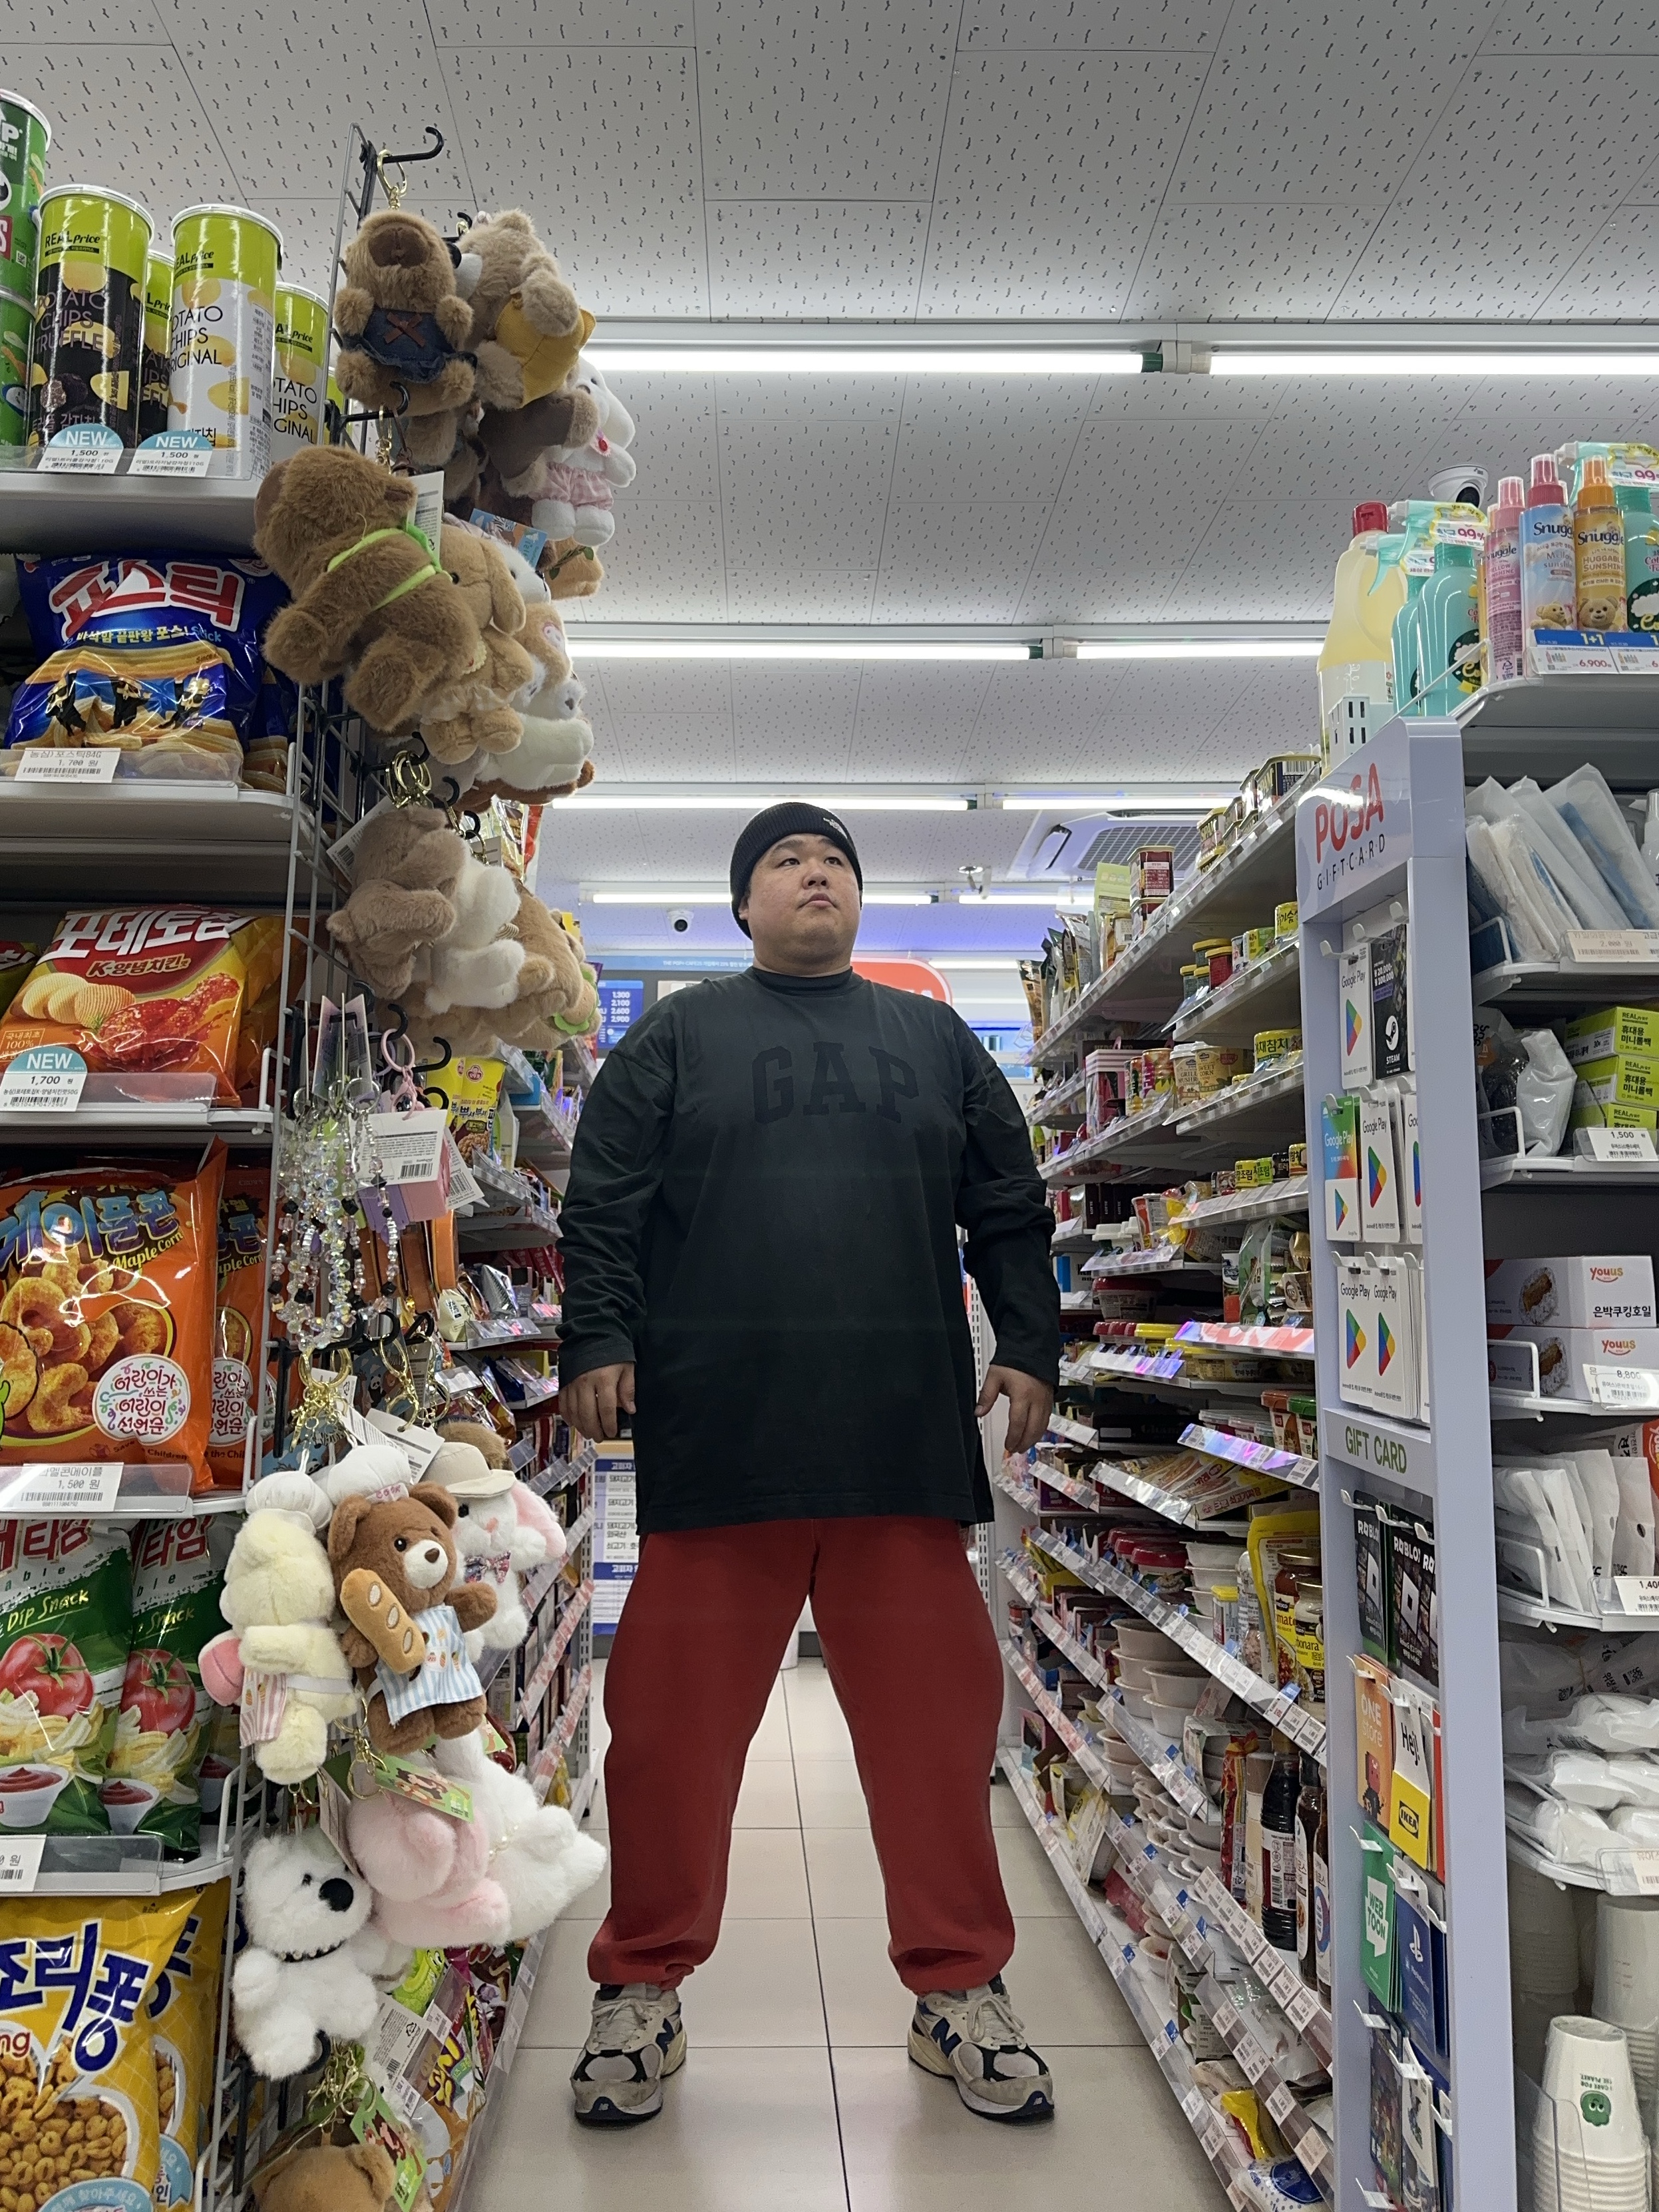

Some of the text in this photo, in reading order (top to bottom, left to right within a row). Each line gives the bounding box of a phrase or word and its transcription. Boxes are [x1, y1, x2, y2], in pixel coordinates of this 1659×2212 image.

[65, 431, 108, 447] NEW
[155, 436, 199, 449] NEW
[51, 559, 242, 639] 포스틱
[1580, 632, 1605, 646] 1+1
[1579, 659, 1608, 668] 6,900
[37, 909, 261, 967] 포테토칩
[1341, 974, 1357, 989] Google
[1356, 969, 1366, 984] Play
[6, 1040, 35, 1050] 100%
[26, 1053, 73, 1069] NEW
[1386, 1053, 1401, 1065] STEAM
[31, 1076, 61, 1086] 1,700
[752, 1040, 920, 1124] GAP
[1362, 1117, 1387, 1136] Google Play
[1324, 1130, 1354, 1150] Google Play
[113, 1231, 184, 1270] Maple Corn
[242, 1254, 264, 1267] Corn
[1590, 1267, 1624, 1281] youus
[1340, 1282, 1371, 1301] Google Play
[1374, 1285, 1397, 1303] Google Play
[1592, 1305, 1652, 1318] 은박쿠킹호일
[1601, 1339, 1636, 1353] youus
[1616, 1370, 1642, 1380] 8,800
[1345, 1425, 1407, 1475] GIFT CARD
[57, 1478, 100, 1490] 1,500 원
[7, 1589, 89, 1632] Dip Snack
[1361, 1693, 1382, 1728] ONE
[1362, 1720, 1383, 1748] store
[1400, 1722, 1421, 1767] Hej!
[1400, 1808, 1417, 1828] IKEA
[1369, 1890, 1383, 1920] WEB
[1367, 1905, 1385, 1941] TOON
